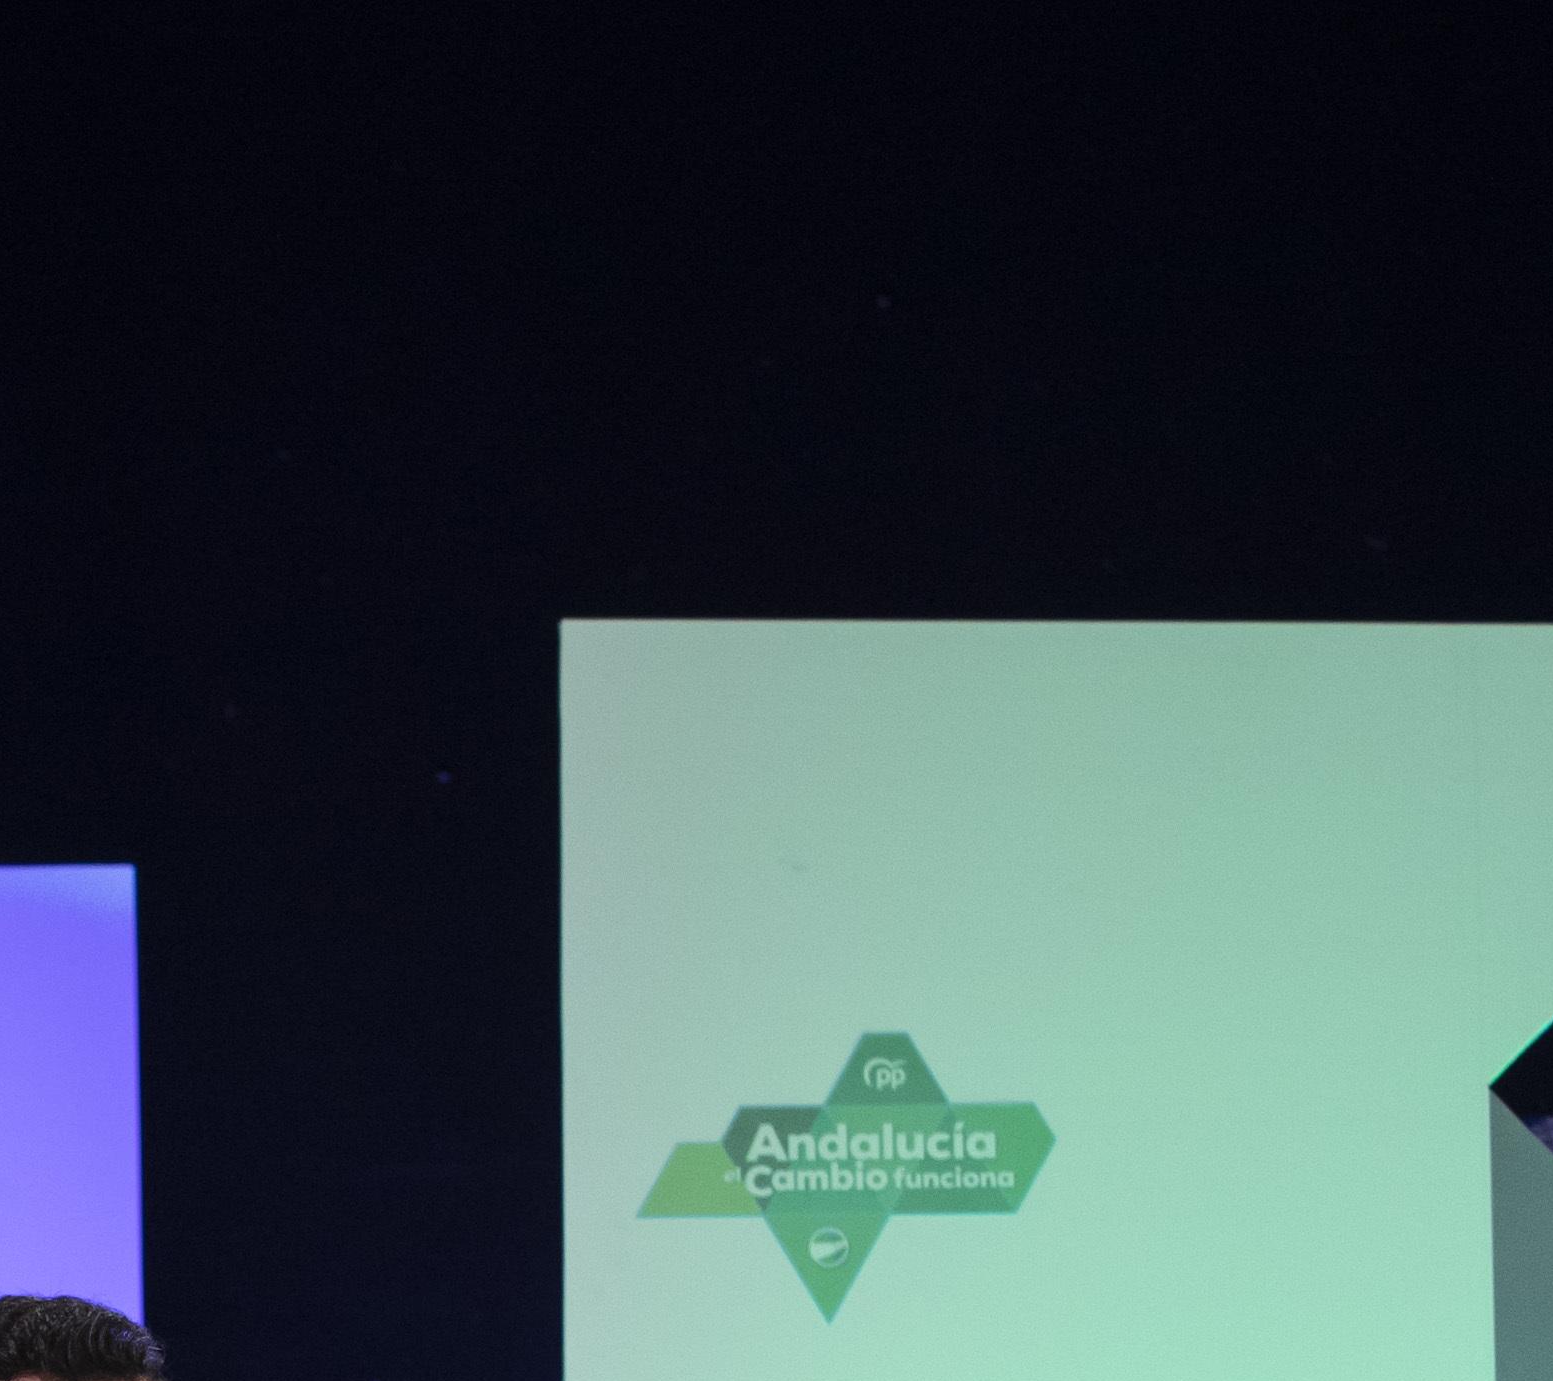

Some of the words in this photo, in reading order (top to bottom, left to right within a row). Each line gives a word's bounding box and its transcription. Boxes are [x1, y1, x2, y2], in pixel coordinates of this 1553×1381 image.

[746, 1121, 997, 1162] Andalucía
[745, 1161, 888, 1198] Cambio
[895, 1166, 1016, 1190] funciona
